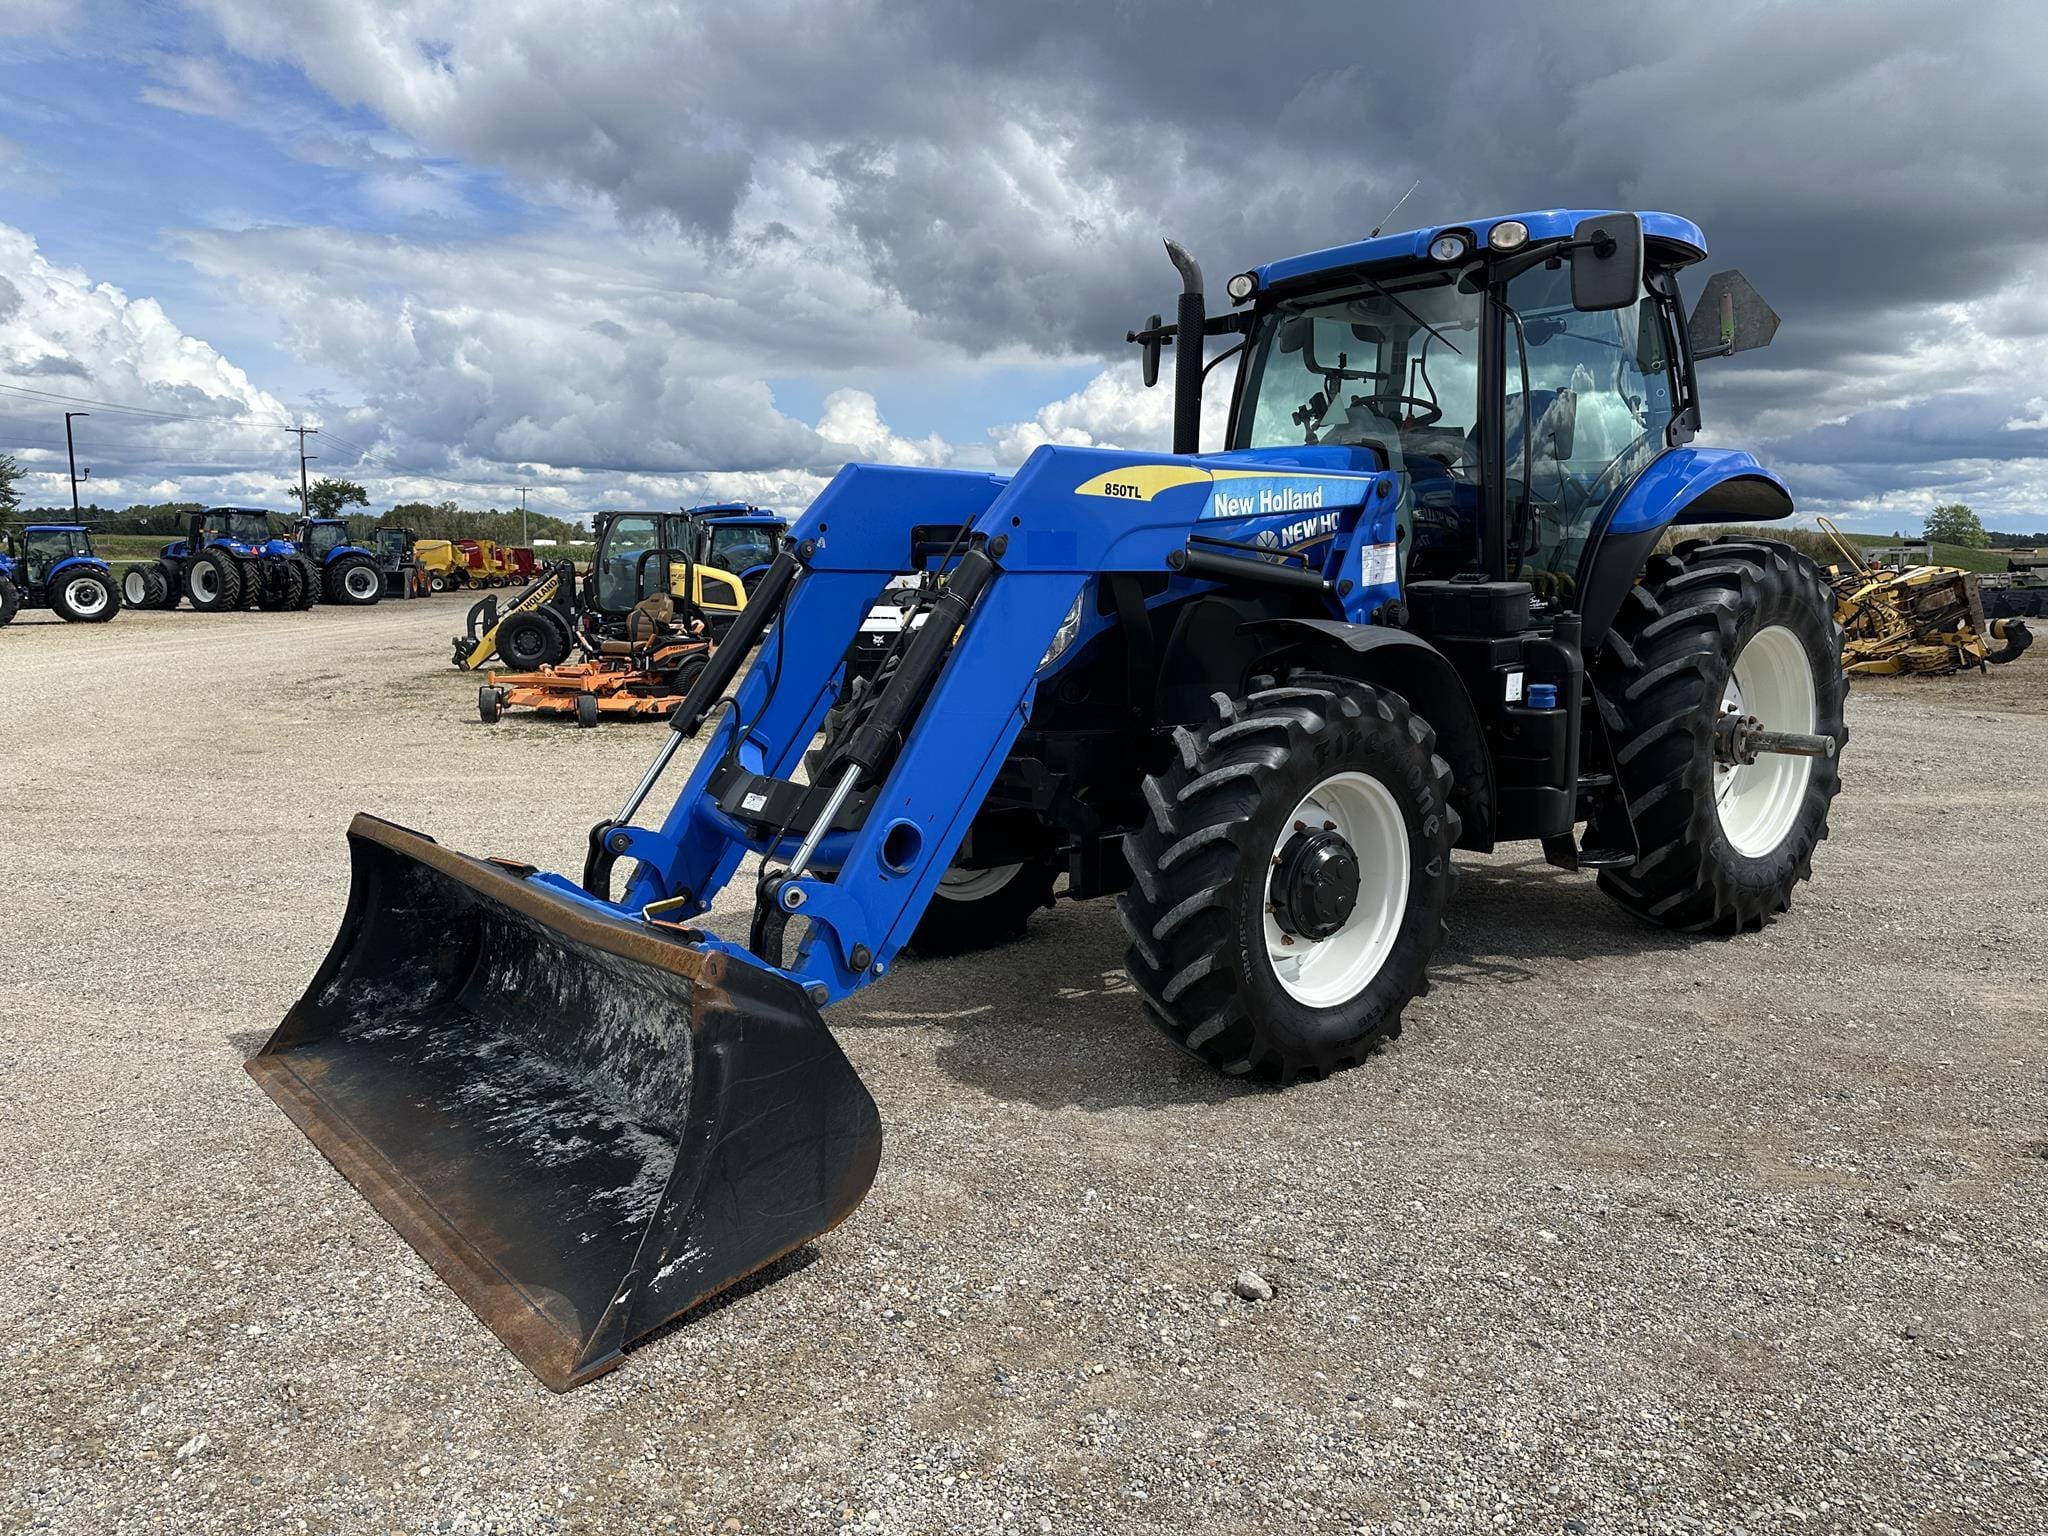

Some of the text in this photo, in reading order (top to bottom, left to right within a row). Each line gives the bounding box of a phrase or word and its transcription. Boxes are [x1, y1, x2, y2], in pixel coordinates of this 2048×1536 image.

[1104, 482, 1142, 499] 850TL
[1214, 485, 1322, 517] New Holland
[1281, 517, 1318, 547] NEW
[523, 579, 558, 610] HOLLAND
